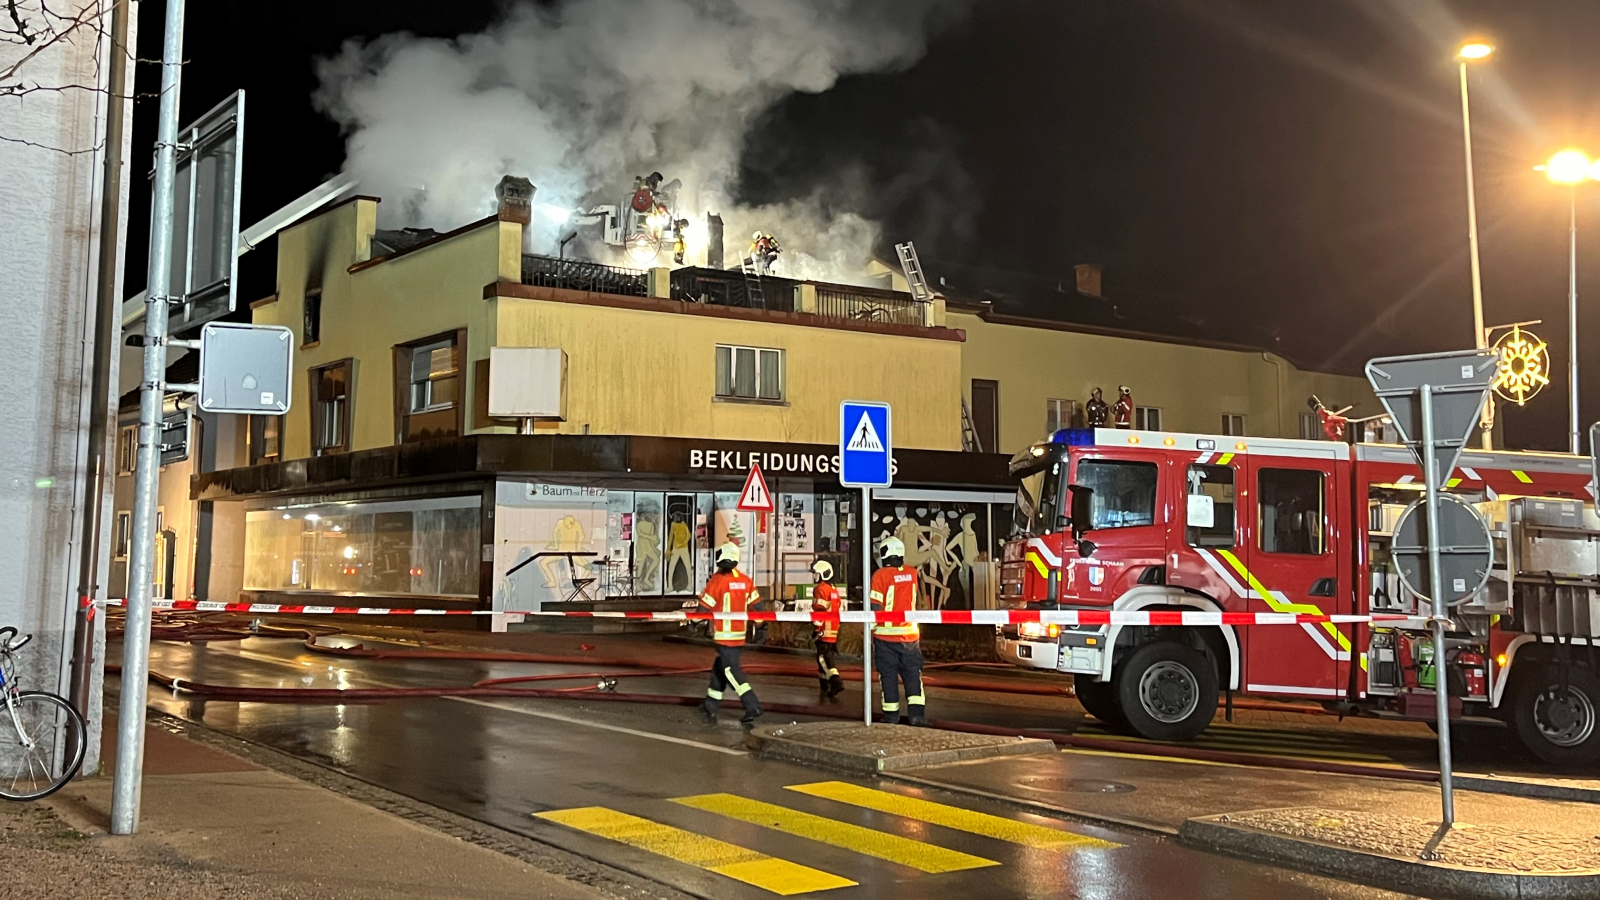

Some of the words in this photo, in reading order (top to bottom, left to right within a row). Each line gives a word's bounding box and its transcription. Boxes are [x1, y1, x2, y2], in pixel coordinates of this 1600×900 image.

[690, 449, 898, 476] BEKLEIDUNGSS
[542, 484, 573, 496] Baum
[580, 486, 606, 497] Herz
[1171, 553, 1179, 569] 1
